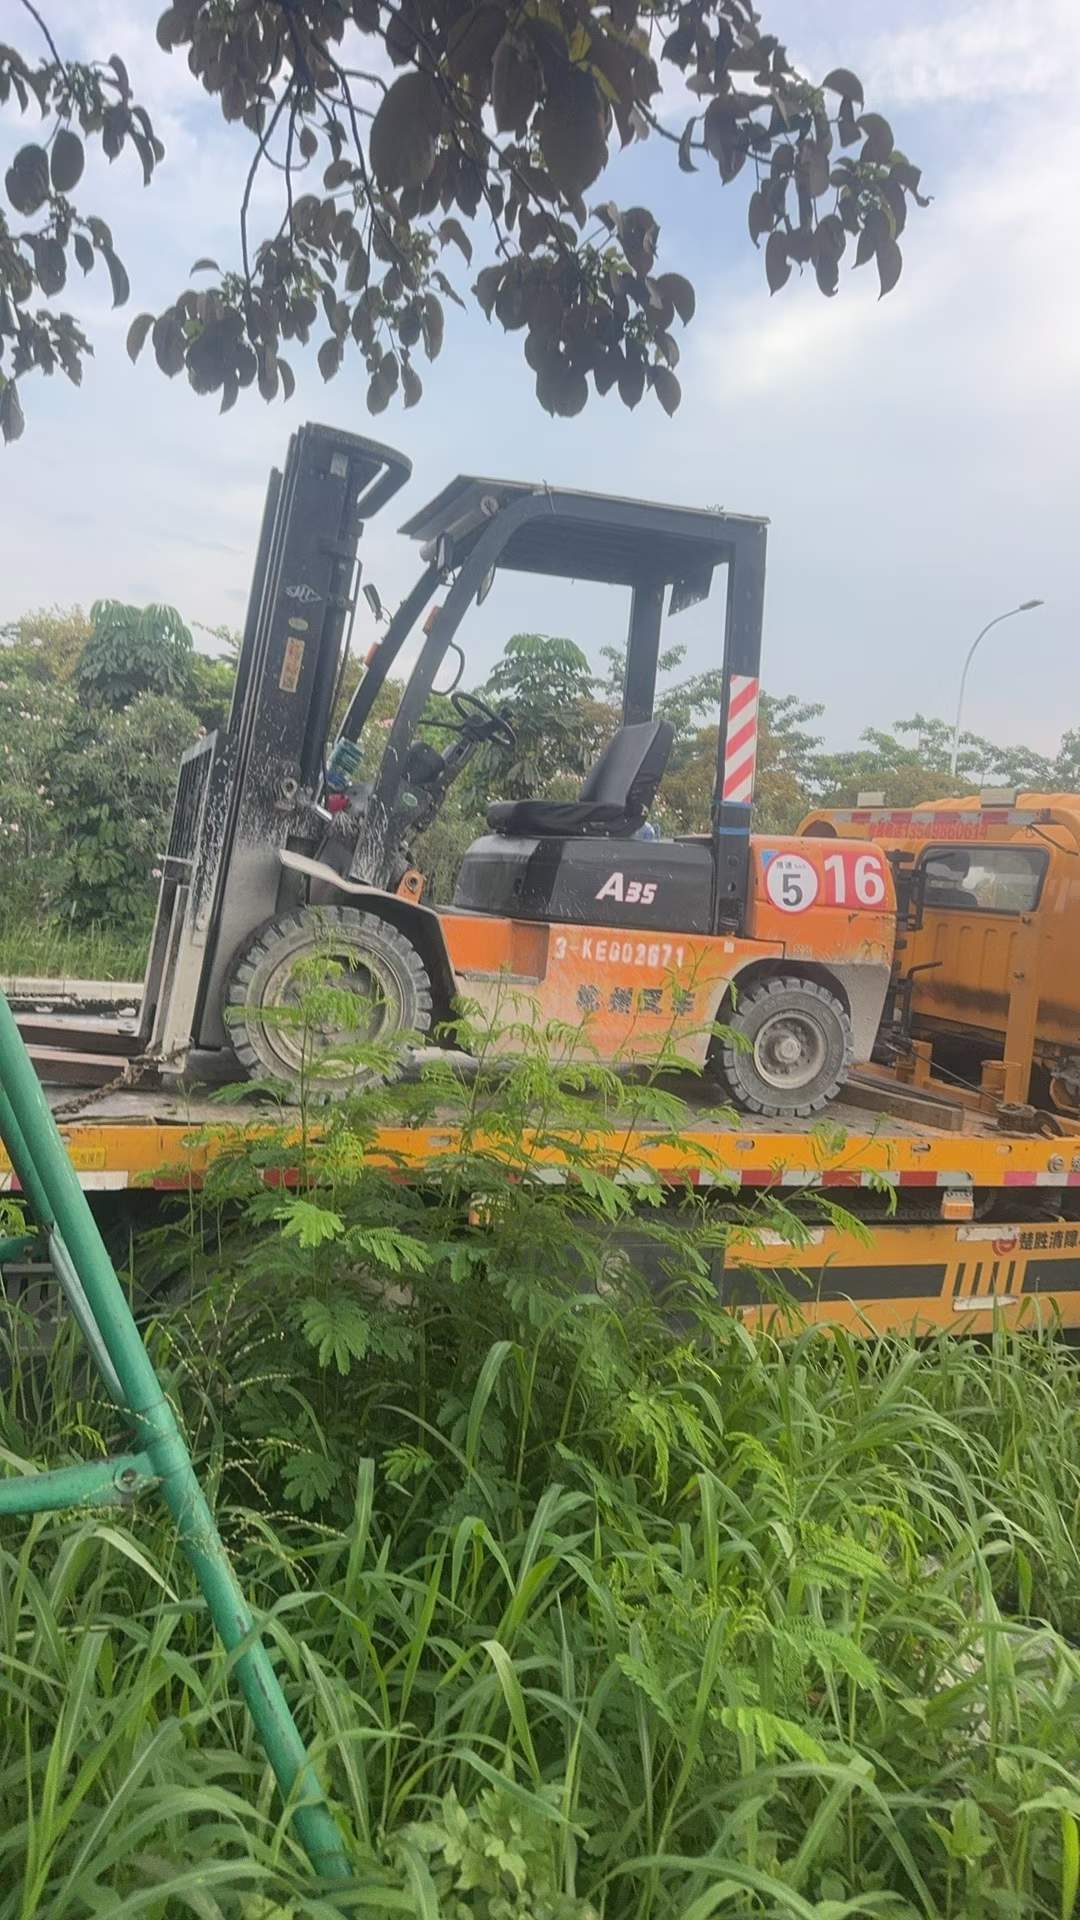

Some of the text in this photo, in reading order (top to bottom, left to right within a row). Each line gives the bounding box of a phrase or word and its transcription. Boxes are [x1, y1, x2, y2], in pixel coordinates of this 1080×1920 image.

[595, 872, 657, 904] A35
[783, 873, 803, 907] 5
[824, 855, 885, 905] 16
[1019, 1230, 1080, 1250] 楚胜清障
